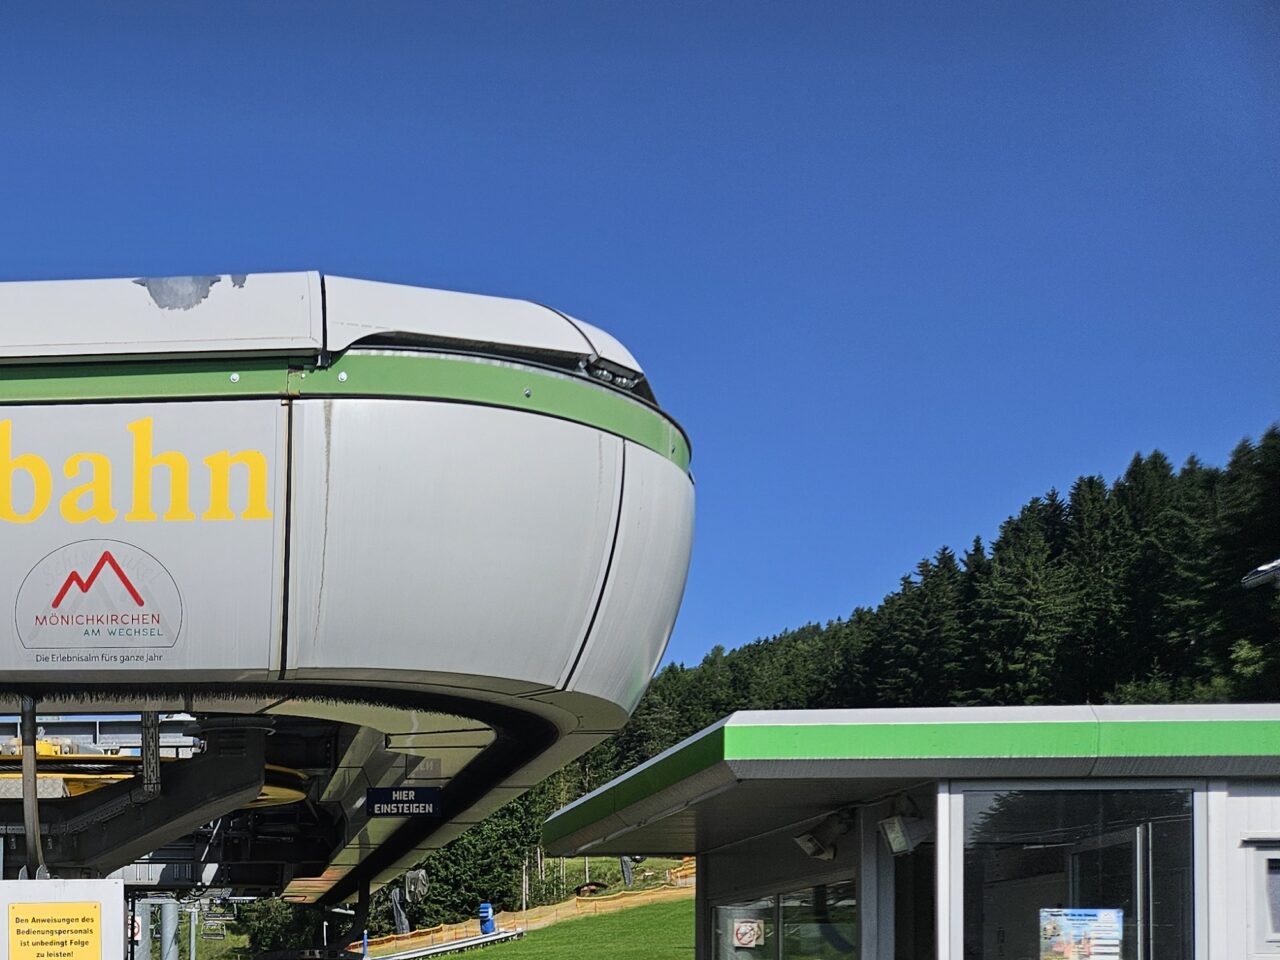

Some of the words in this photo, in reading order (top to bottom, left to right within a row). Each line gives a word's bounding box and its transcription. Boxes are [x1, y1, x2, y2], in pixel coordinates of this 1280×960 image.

[35, 612, 161, 626] MÖNICHKIRCHEN
[83, 628, 101, 637] AM
[107, 628, 164, 637] WECHSEL
[35, 654, 50, 663] Die
[51, 654, 100, 663] Erlebnisalm
[101, 653, 118, 662] fürs
[120, 655, 145, 664] ganze
[145, 653, 163, 663] Jahr
[392, 790, 415, 801] HIER
[374, 803, 433, 814] EINSTEIGEN
[15, 916, 29, 924] Den
[31, 916, 80, 925] Anweisungen
[16, 928, 94, 936] Bedienungspersonals
[31, 940, 68, 948] unbedingt
[70, 939, 90, 947] Folge
